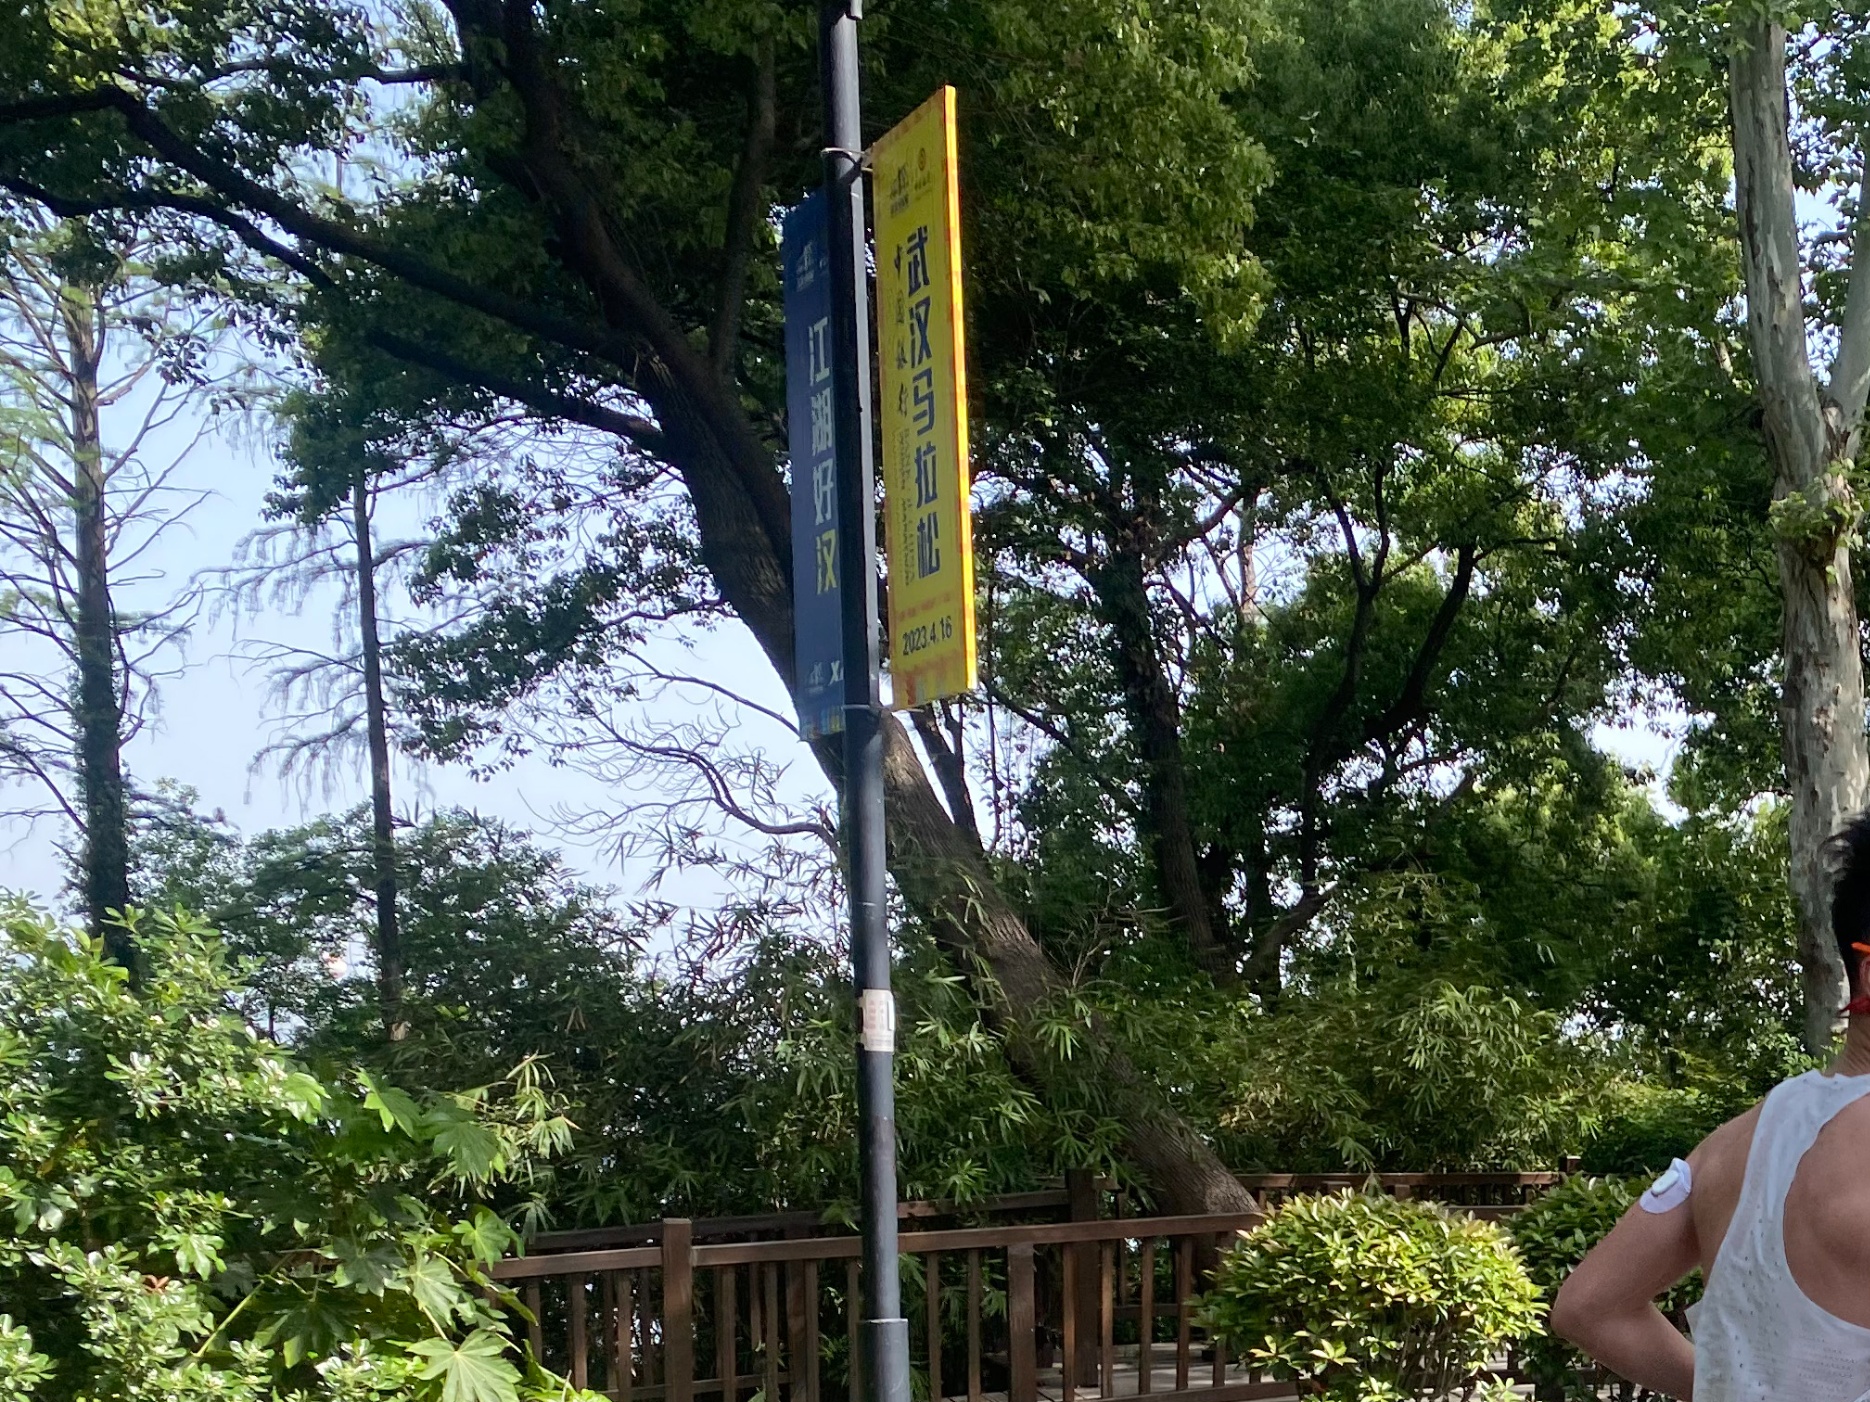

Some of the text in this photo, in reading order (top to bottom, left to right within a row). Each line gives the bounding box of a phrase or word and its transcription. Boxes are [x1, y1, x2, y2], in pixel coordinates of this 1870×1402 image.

[808, 316, 838, 595] 江湖好汉
[906, 225, 941, 580] 武汉马拉松
[902, 615, 952, 656] 2023.4.16
